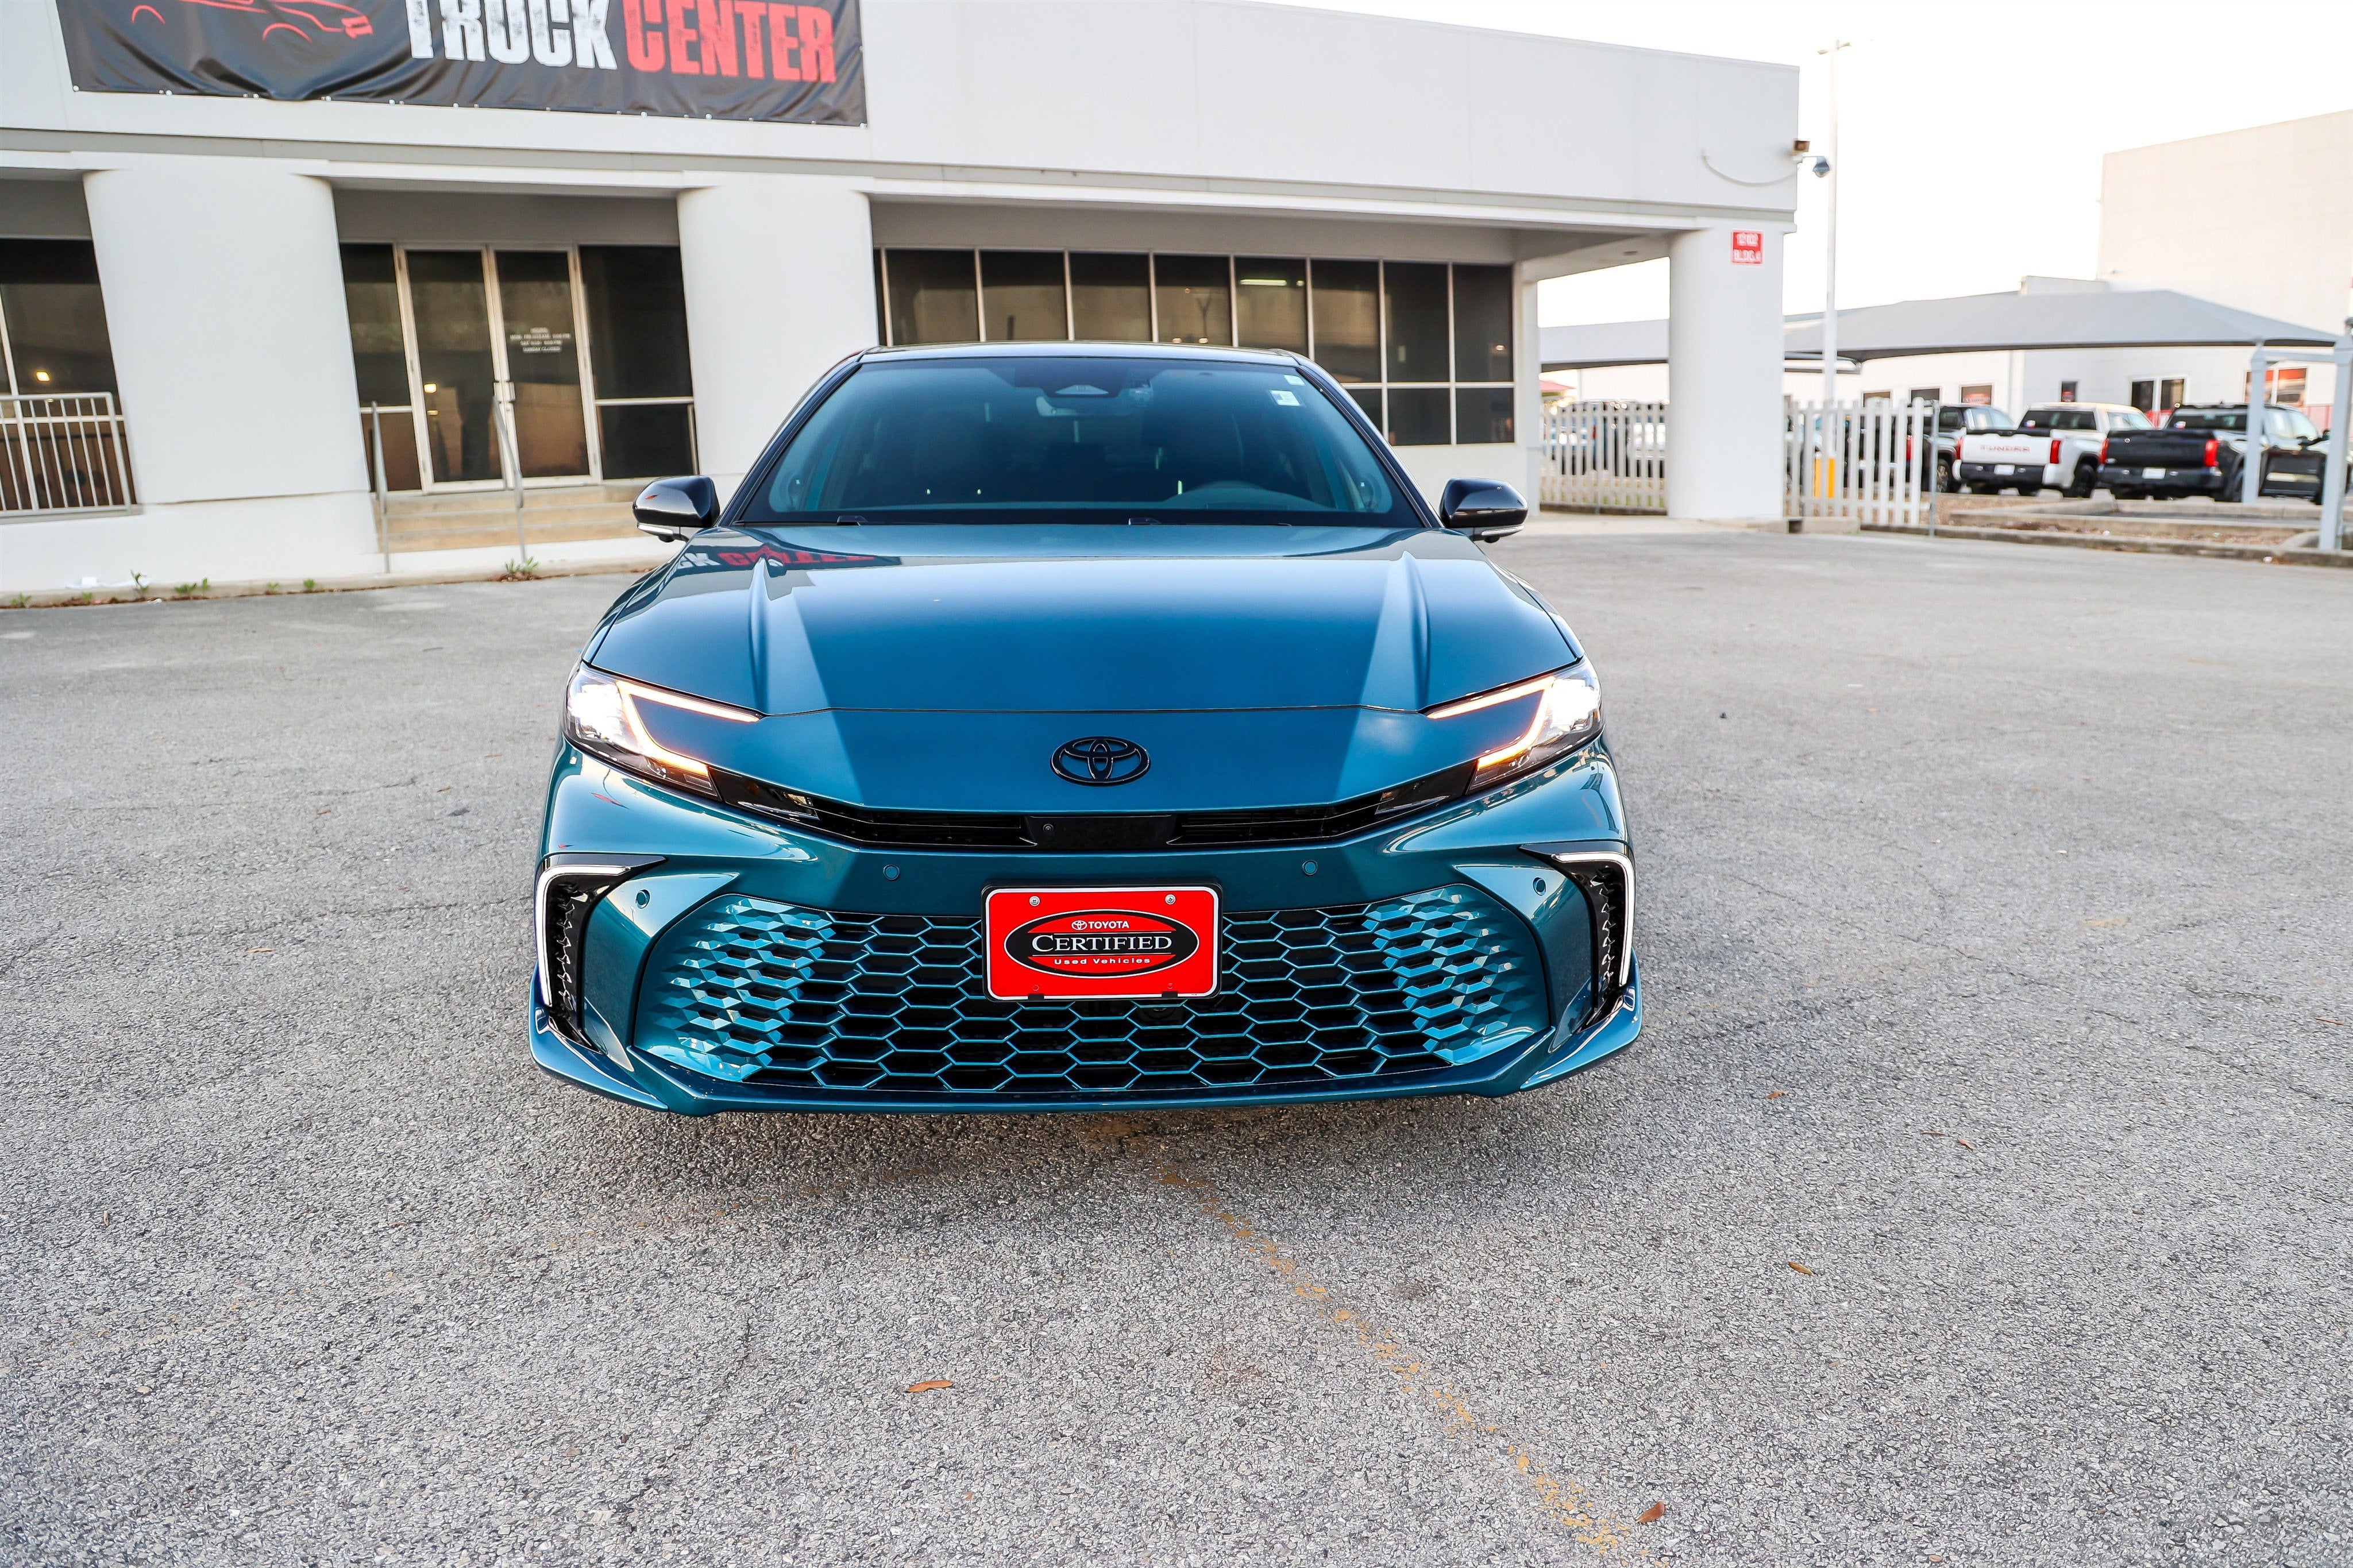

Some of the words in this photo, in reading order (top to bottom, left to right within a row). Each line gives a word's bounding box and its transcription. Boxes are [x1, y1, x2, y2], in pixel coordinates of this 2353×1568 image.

[622, 0, 837, 83] CENTER
[1980, 445, 2031, 453] TUNDRA
[1088, 921, 1130, 929] TOYOTA
[1032, 934, 1172, 952] CERTIFIED
